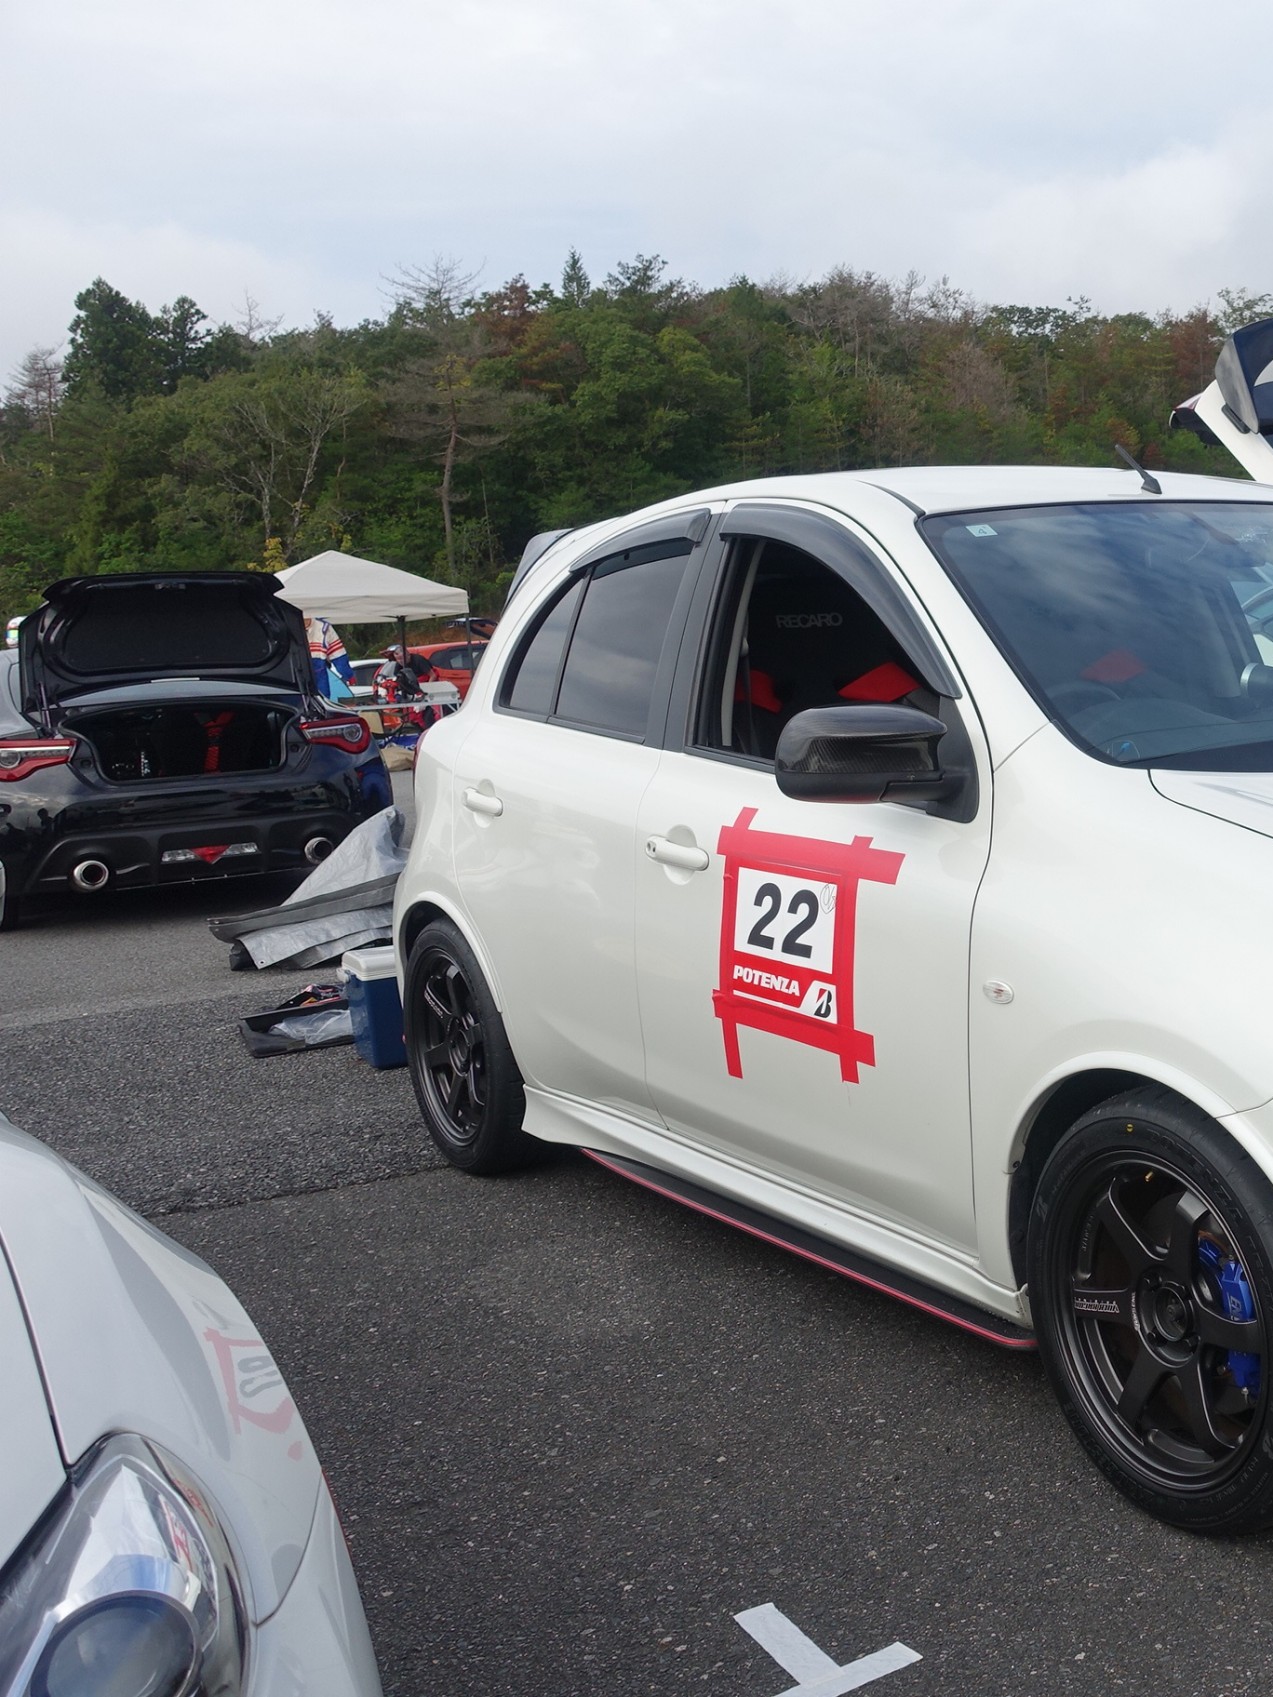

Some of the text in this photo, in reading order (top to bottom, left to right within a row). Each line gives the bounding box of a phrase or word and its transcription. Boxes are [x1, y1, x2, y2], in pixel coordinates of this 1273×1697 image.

[775, 612, 843, 629] RECARO
[747, 882, 820, 959] 22
[733, 965, 800, 996] POTENZA
